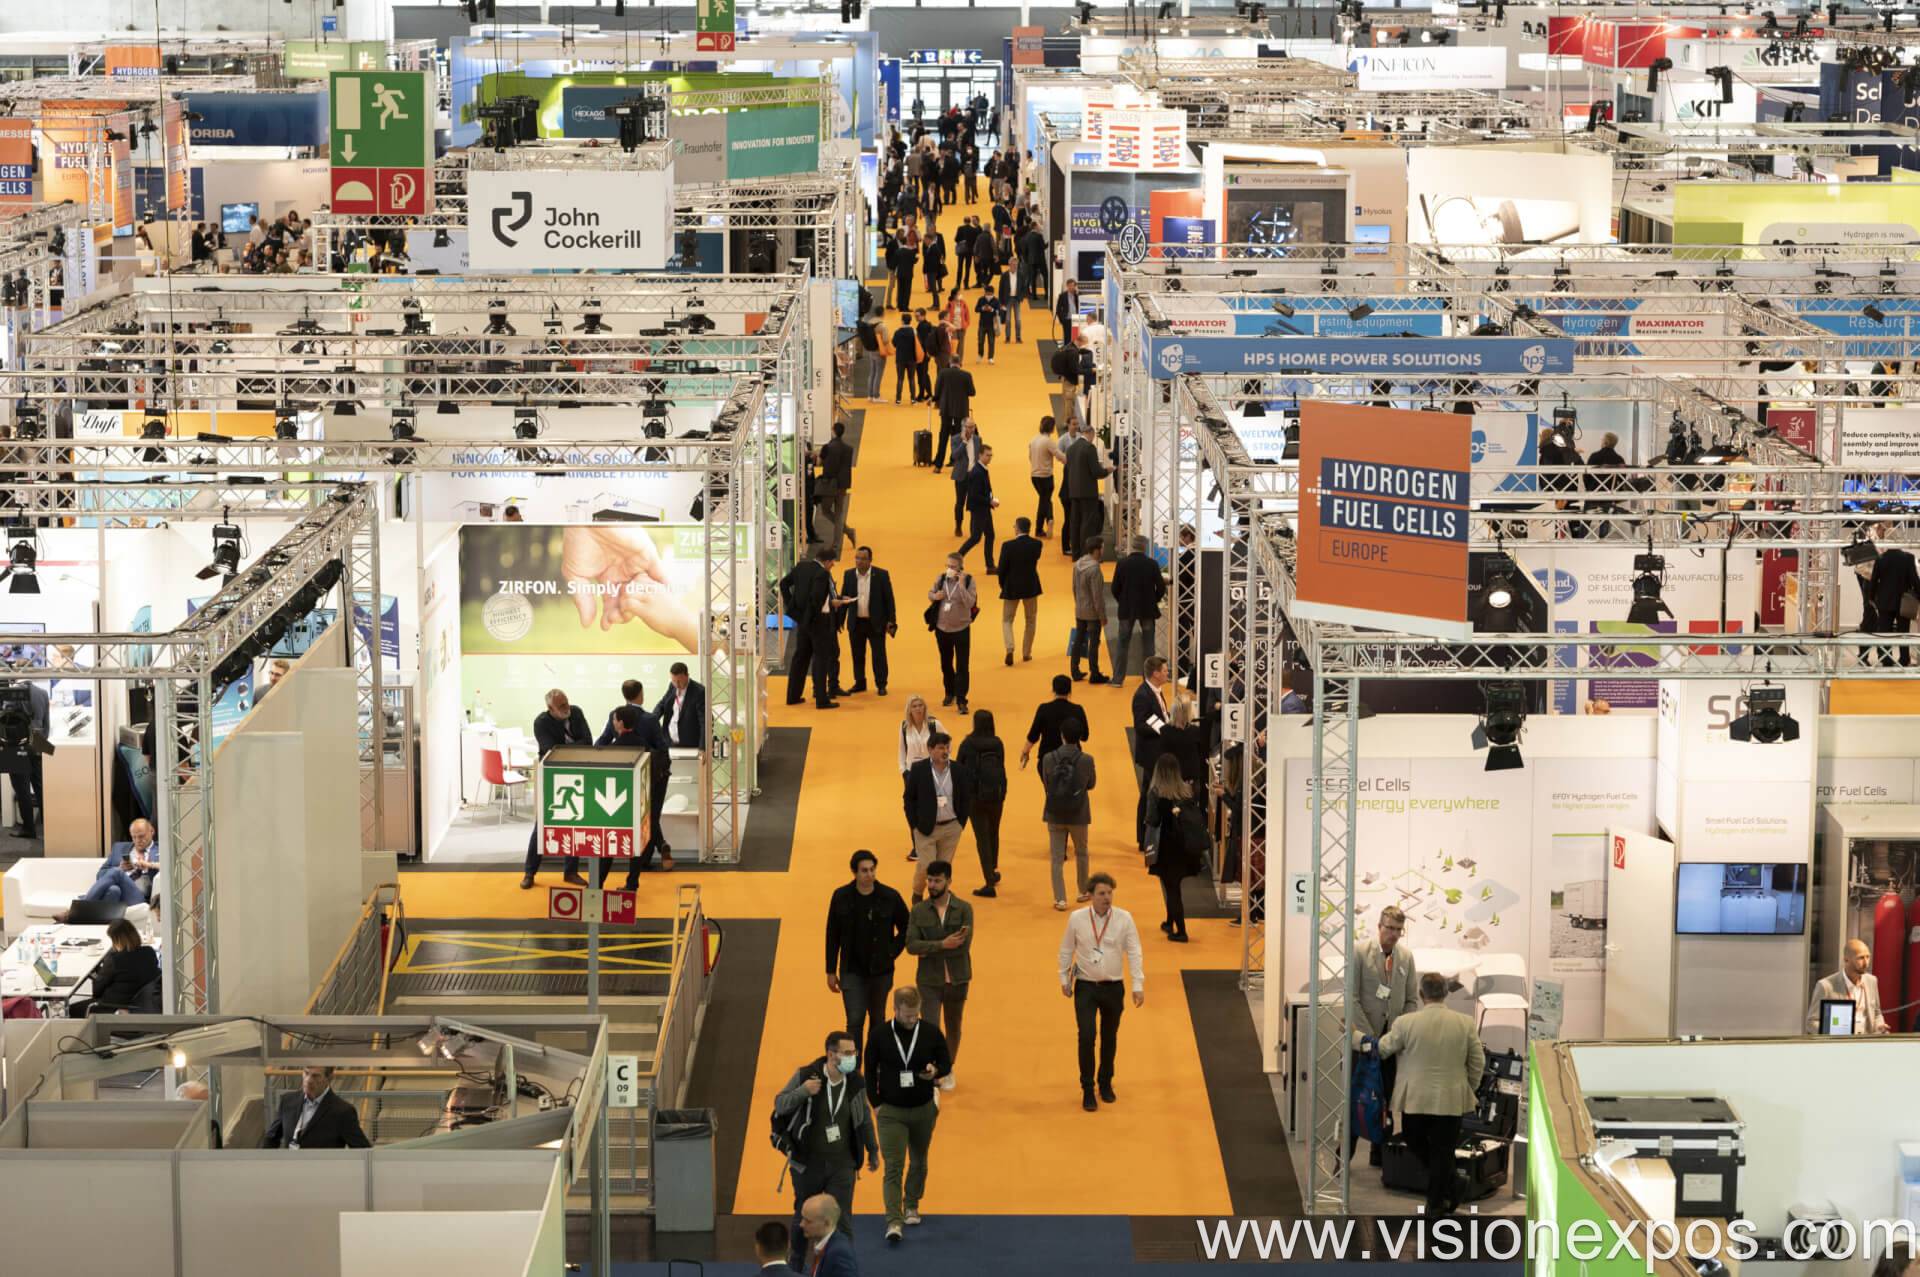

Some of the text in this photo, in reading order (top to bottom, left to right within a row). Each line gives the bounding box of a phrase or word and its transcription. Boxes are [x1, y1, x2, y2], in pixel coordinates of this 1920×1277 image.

[116, 67, 159, 76] HYDROGEN
[574, 110, 606, 118] HEXAGO
[1692, 100, 1723, 117] KIT
[684, 141, 722, 155] Fraunhofer
[731, 134, 815, 151] INNOVATION FOR INDUSTRY
[544, 207, 600, 227] John
[544, 229, 641, 249] Cockerill
[1843, 231, 1880, 240] Hydrogen
[1171, 319, 1228, 328] AXIMATOR
[1319, 317, 1351, 329] esting
[1562, 317, 1618, 330] Hydrogen
[1635, 319, 1705, 328] MAXIMATOR
[1243, 352, 1482, 367] HPS HOME POWER SOLUTIONS
[1240, 429, 1284, 439] WELTWE
[1333, 461, 1457, 501] HYDROGEN
[1332, 498, 1456, 539] FUEL CELLS
[1331, 539, 1390, 563] EUROPE
[1587, 574, 1609, 582] OEM
[1664, 574, 1744, 582] MANUFACTUERS
[498, 580, 562, 595] ZIRFON.
[566, 579, 621, 598] Simply
[1587, 584, 1600, 592] OF
[1210, 660, 1219, 671] C
[1230, 710, 1239, 722] C
[1375, 778, 1410, 792] Cells
[1816, 786, 1888, 796] FOY Fuel Cells
[1355, 797, 1405, 814] energy
[1409, 796, 1501, 814] everywhere
[1295, 879, 1306, 894] C
[617, 1064, 629, 1081] C
[616, 1084, 629, 1093] 09
